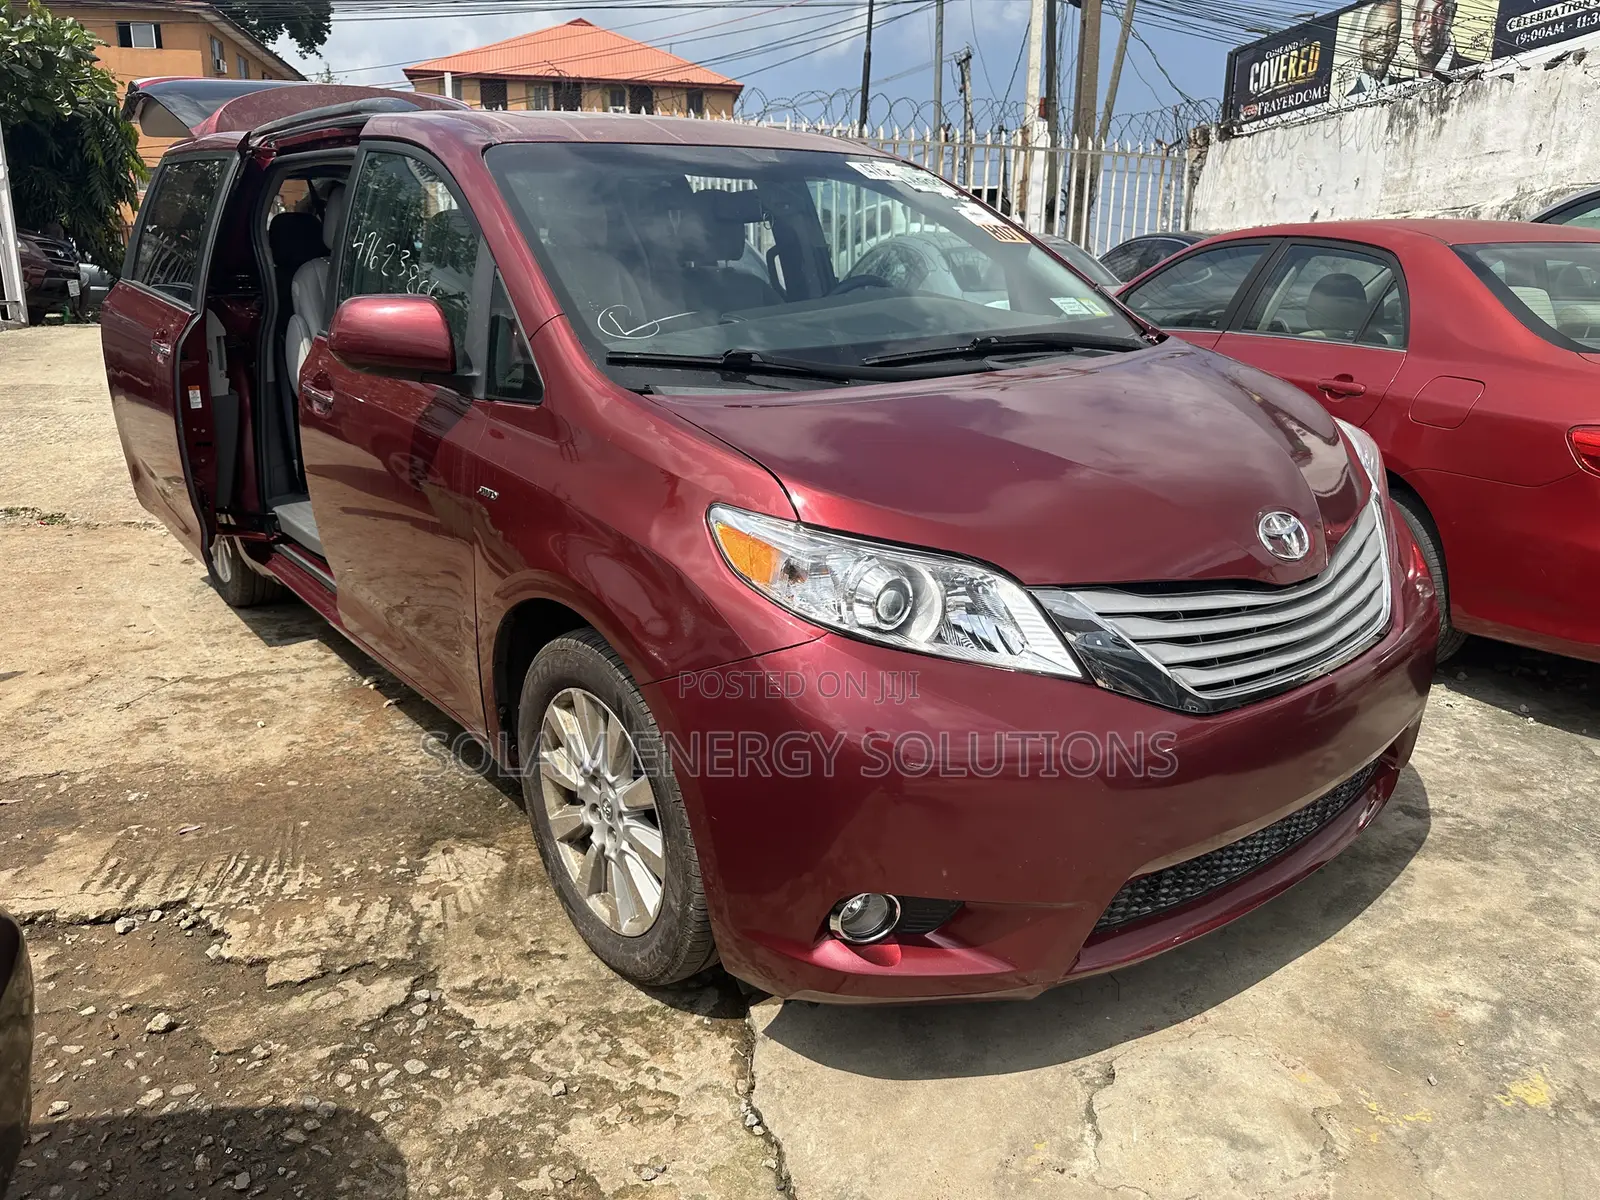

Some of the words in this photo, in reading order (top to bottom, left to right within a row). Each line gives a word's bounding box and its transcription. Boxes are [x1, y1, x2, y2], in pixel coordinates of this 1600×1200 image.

[1508, 0, 1590, 29] CELEBRATION
[1515, 21, 1565, 46] (9:00AM
[1576, 12, 1600, 29] 11:3
[1248, 41, 1321, 95] COVERED
[1258, 83, 1329, 116] PRAYERDOME
